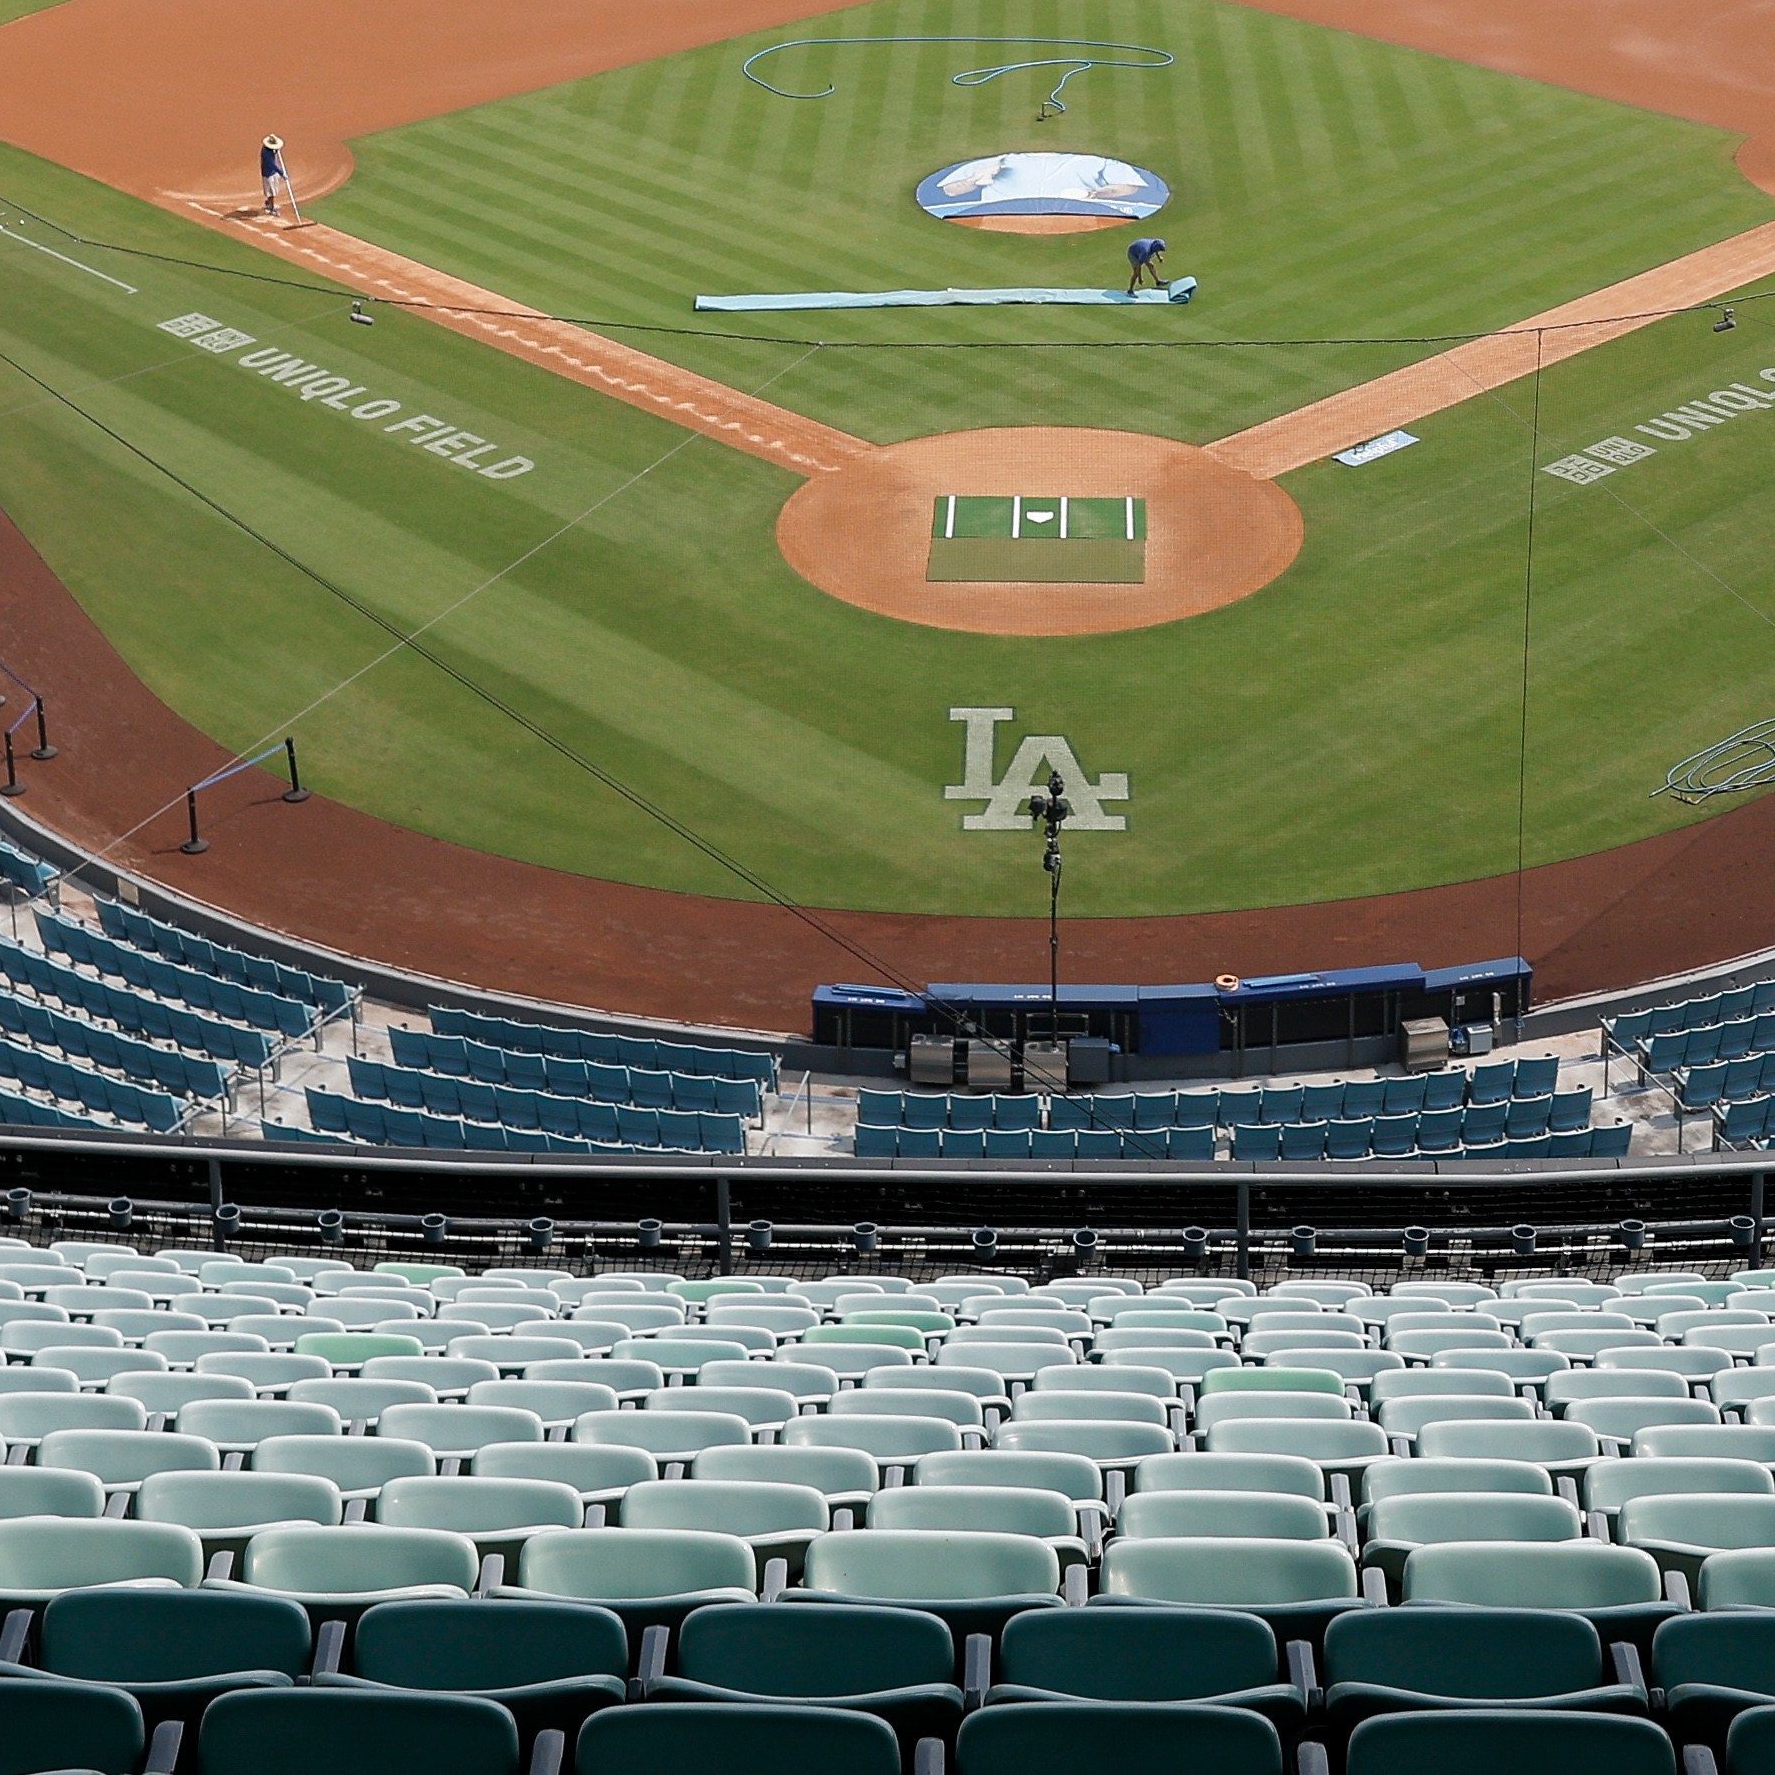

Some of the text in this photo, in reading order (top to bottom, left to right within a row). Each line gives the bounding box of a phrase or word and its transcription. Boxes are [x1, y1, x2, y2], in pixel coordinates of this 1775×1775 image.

[238, 347, 535, 480] UNIQLO FIELD
[943, 707, 1130, 831] LA
